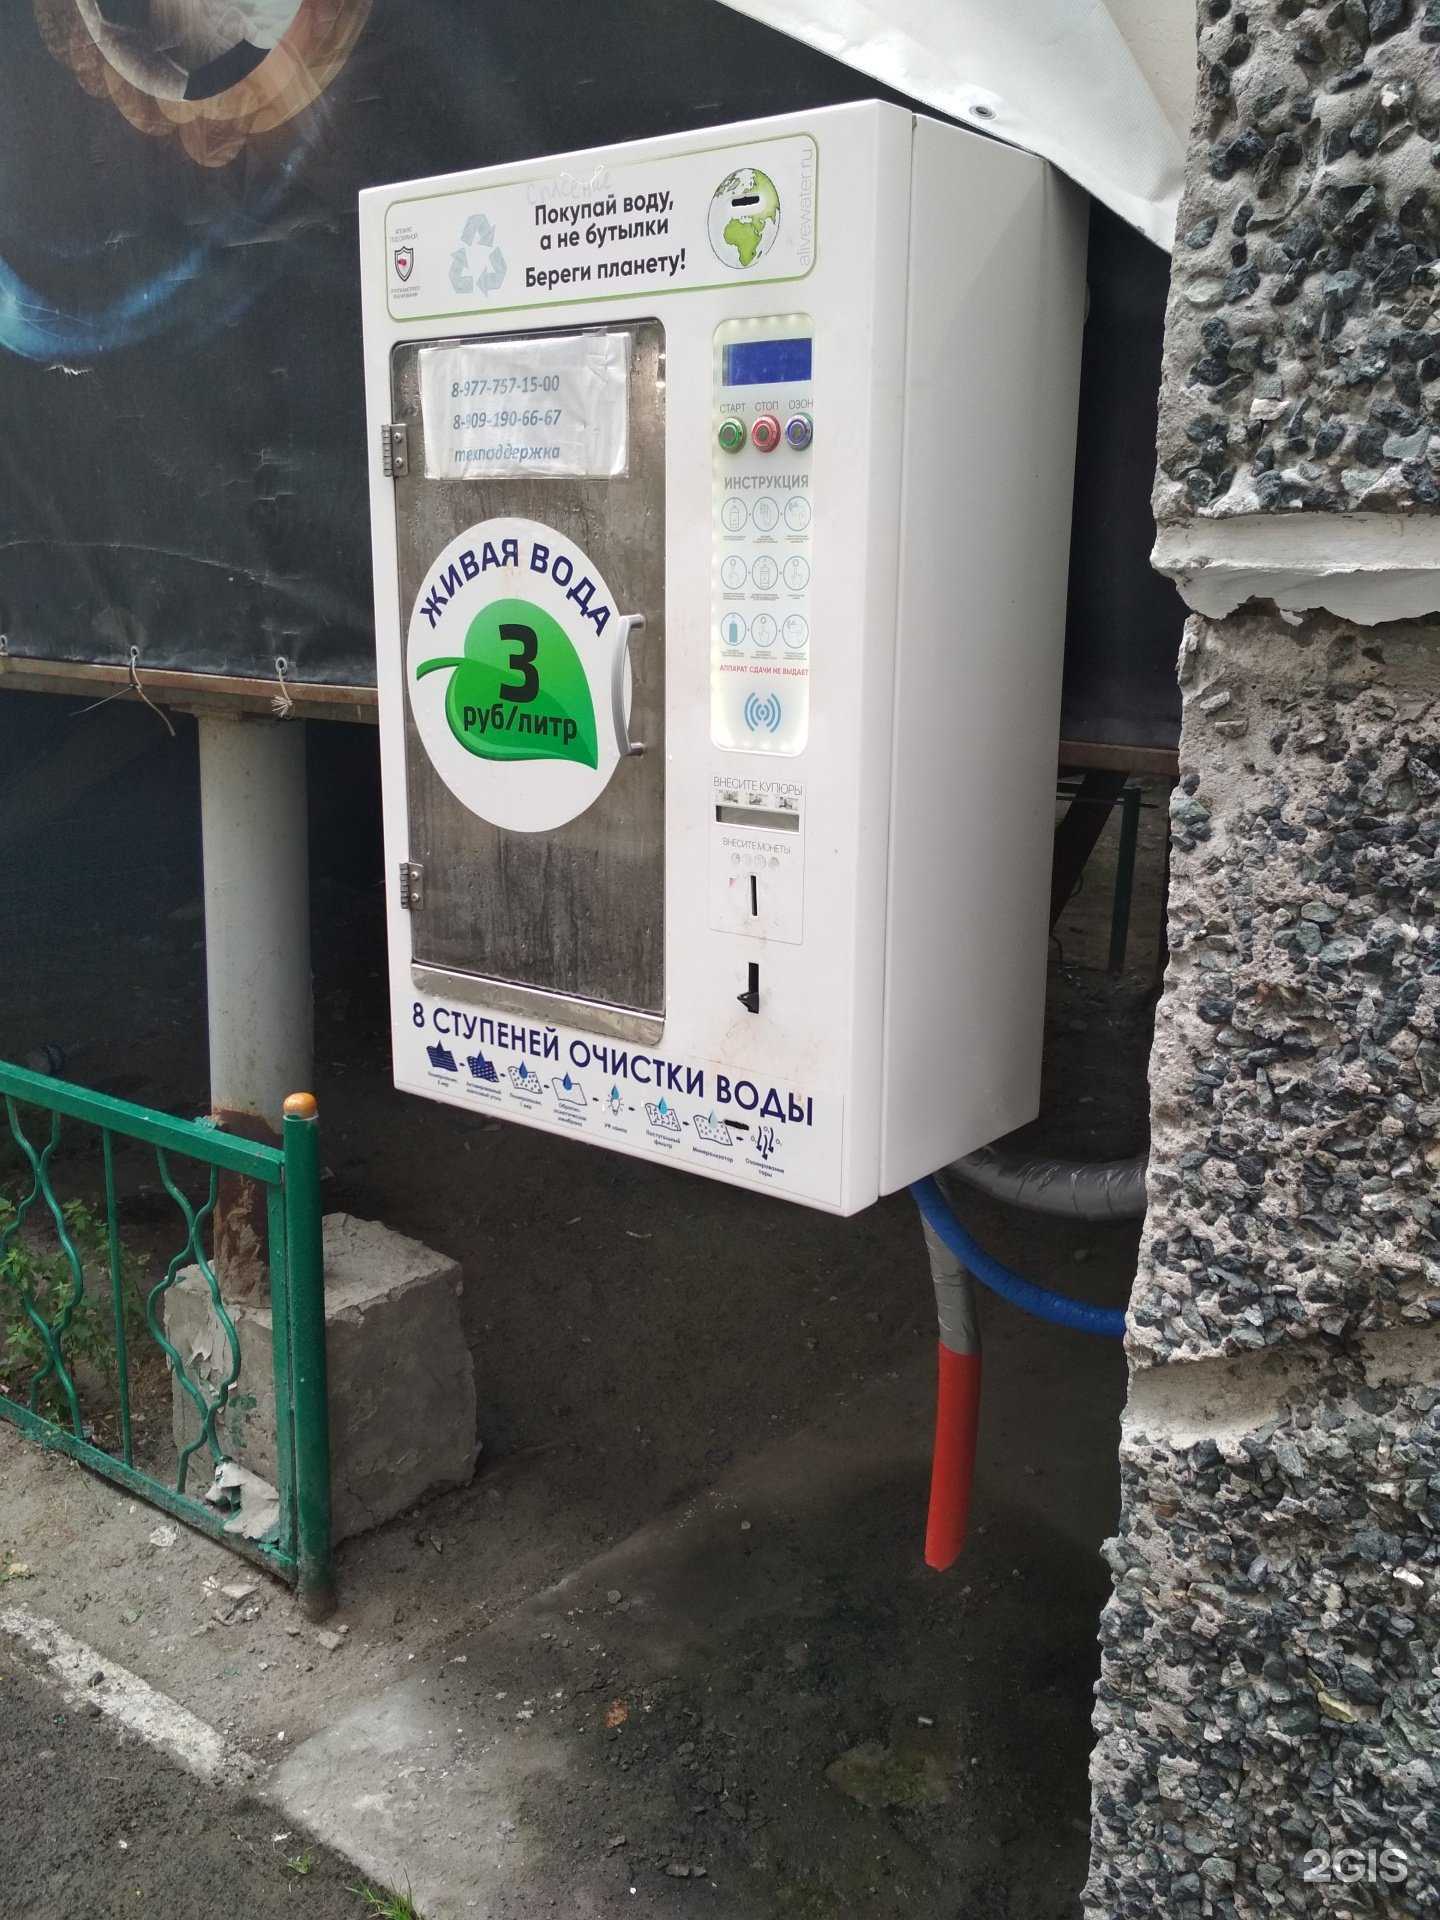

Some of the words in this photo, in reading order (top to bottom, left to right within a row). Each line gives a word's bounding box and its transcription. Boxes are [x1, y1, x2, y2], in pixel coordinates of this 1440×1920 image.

[535, 194, 617, 226] Покупай
[623, 190, 674, 214] воду,
[540, 234, 551, 250] а
[557, 231, 580, 248] не
[585, 218, 669, 248] бутылки
[525, 265, 591, 290] Береги
[597, 248, 686, 279] планету!
[719, 402, 746, 413] СТАРТ
[754, 400, 779, 412] СТОП
[788, 399, 814, 410] ОЗОН
[454, 444, 560, 462] техподдержка
[724, 475, 809, 490] ИНСТРУКЦИЯ
[419, 538, 519, 629] ЖИВАЯ
[529, 543, 611, 637] ВОДА
[499, 623, 540, 704] 3
[720, 665, 748, 673] АППАРАТ
[749, 666, 772, 674] СДАЧИ
[782, 668, 808, 676] ВЫДАЕТ
[463, 703, 578, 745] руб/литр
[713, 776, 758, 791] ВНЕСИТЕ
[759, 781, 803, 796] КУПЮРЫ
[722, 837, 756, 850] ВНЕСИТЕ
[756, 841, 791, 855] МОНЕТЫ
[412, 1002, 425, 1028] 8
[433, 1007, 559, 1061] СТУПЕНЕЙ
[569, 1040, 704, 1098] ОЧИСТКИ
[716, 1074, 813, 1126] ВОДЫ
